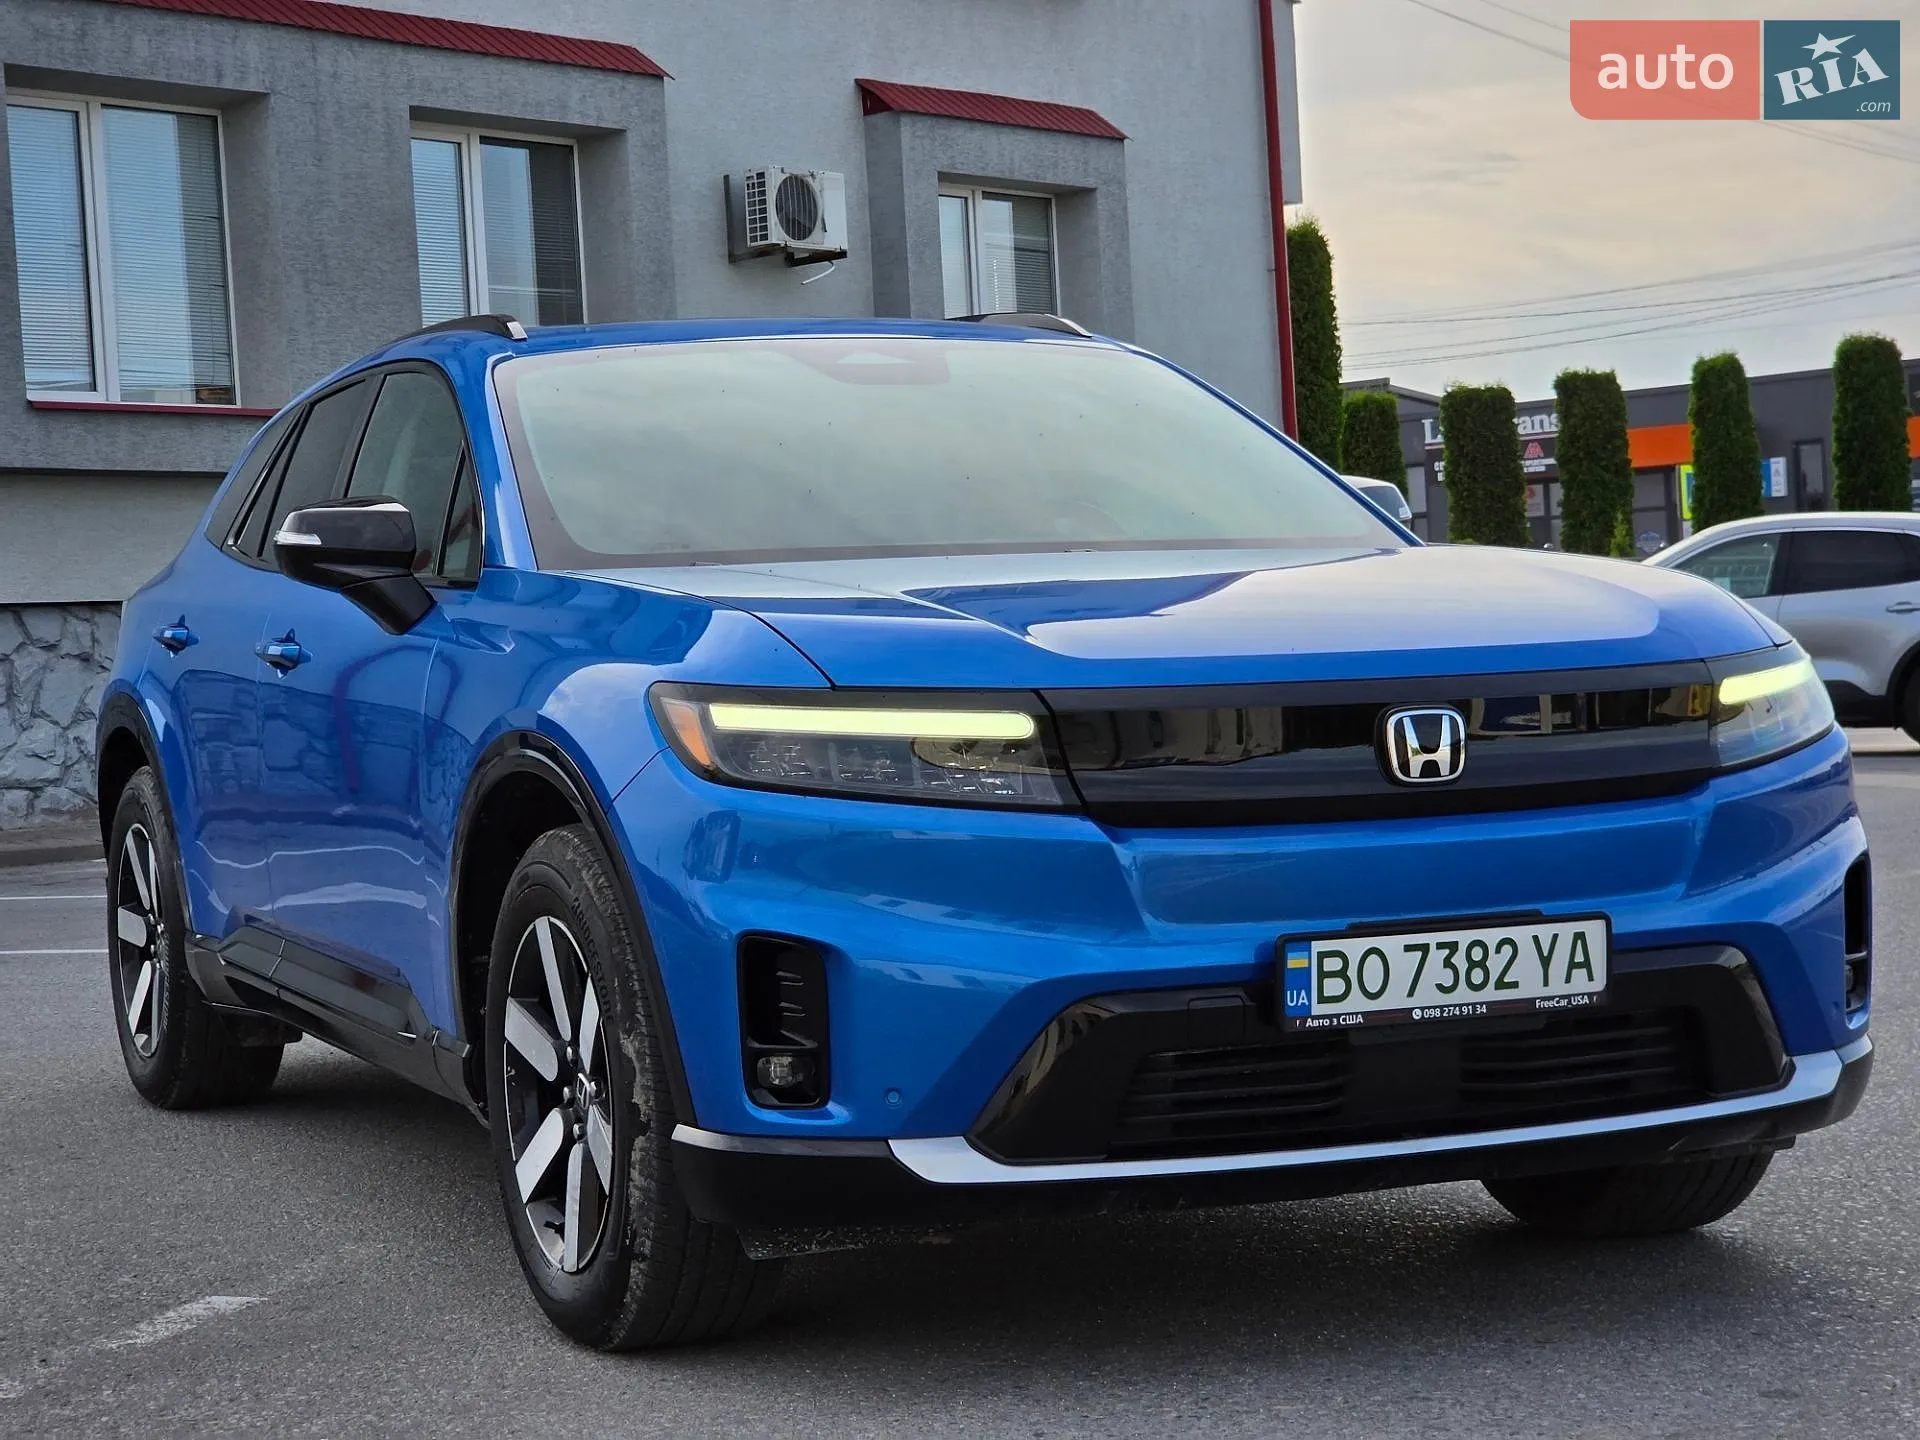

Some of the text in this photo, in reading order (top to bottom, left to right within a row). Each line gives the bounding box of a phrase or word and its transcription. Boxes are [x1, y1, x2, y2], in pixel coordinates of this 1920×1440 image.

[1316, 931, 1595, 1005] BO 7382 YA
[1286, 990, 1309, 1007] UA
[1423, 1004, 1487, 1019] 098 274 91 34
[1305, 1017, 1330, 1028] Авто
[1339, 1014, 1364, 1025] США
